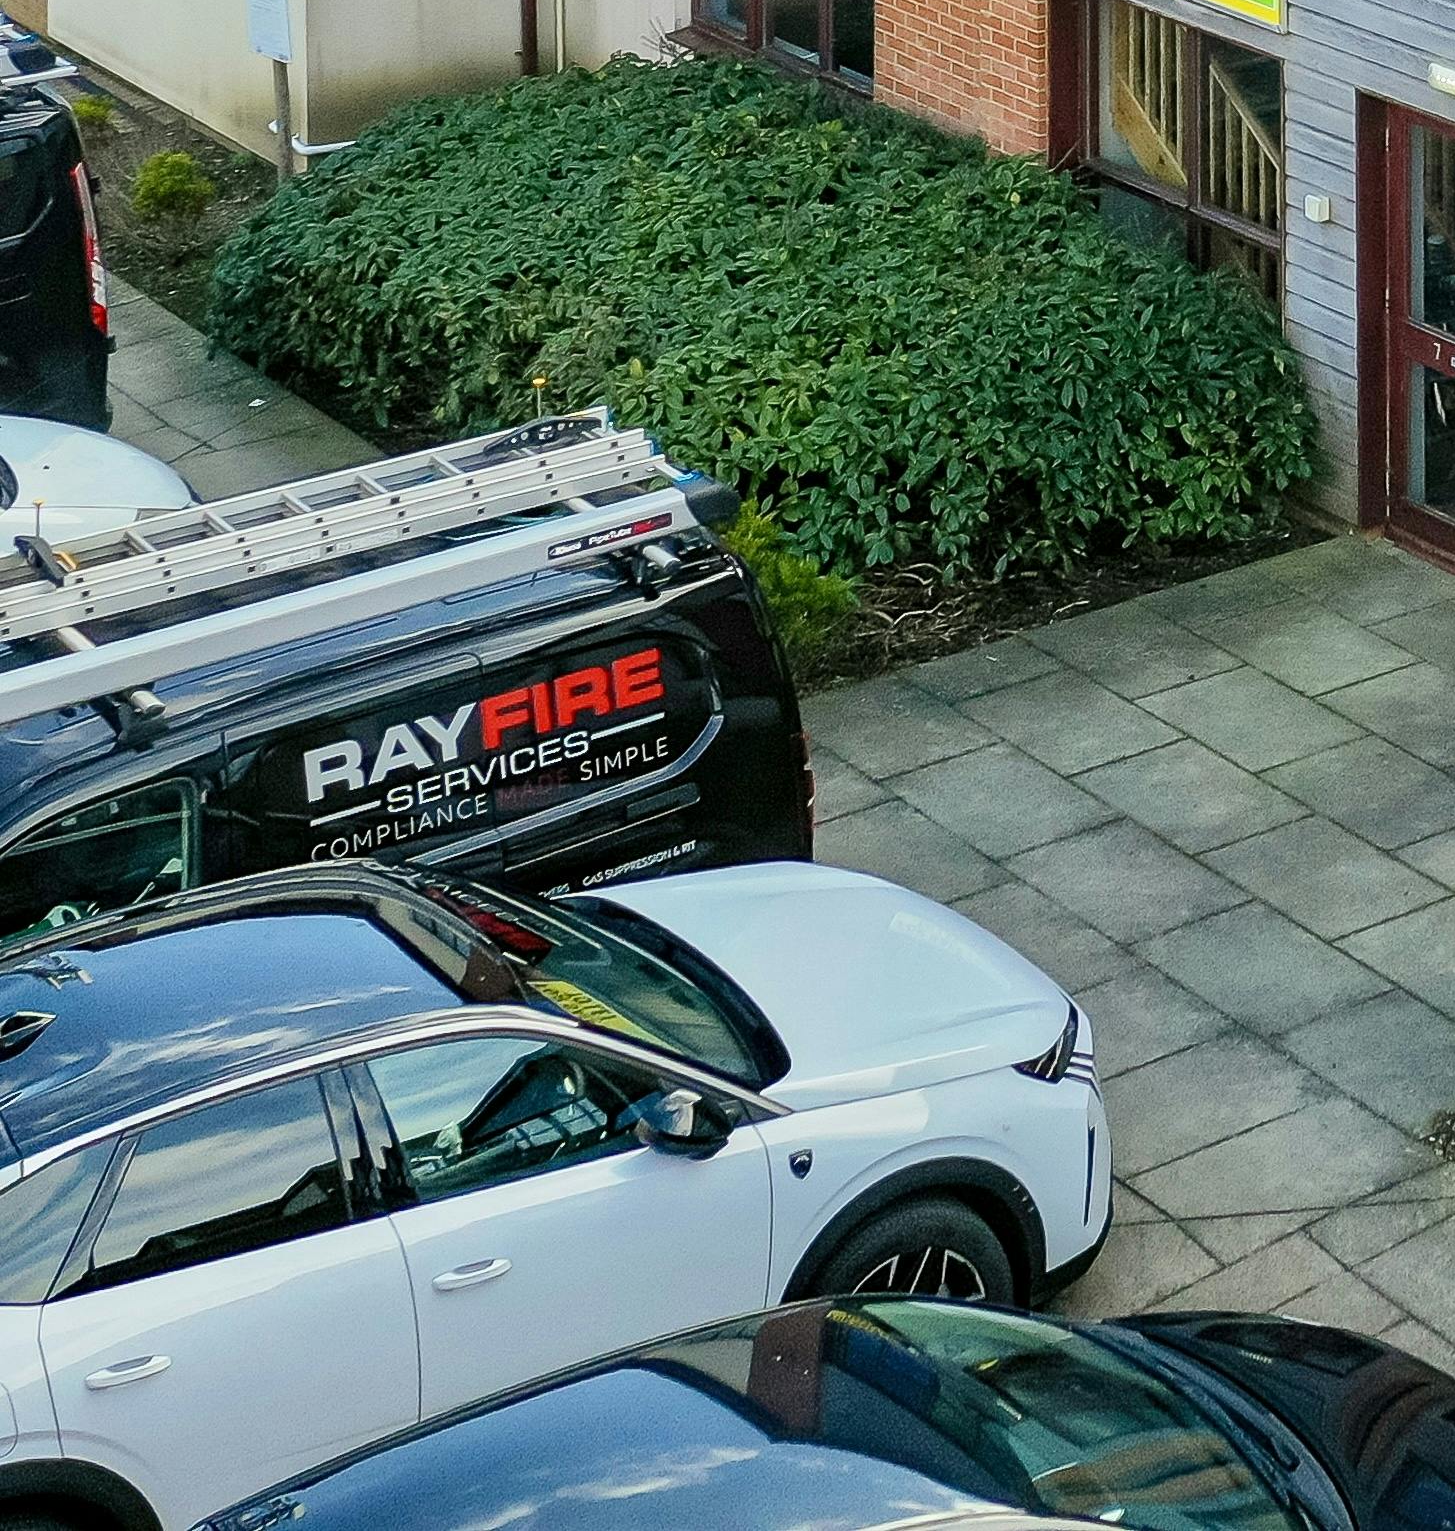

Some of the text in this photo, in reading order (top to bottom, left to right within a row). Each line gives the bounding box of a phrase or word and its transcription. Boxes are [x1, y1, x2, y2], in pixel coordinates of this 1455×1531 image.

[1433, 342, 1441, 360] 7
[303, 647, 666, 805] RAYFIRE
[385, 730, 591, 814] SERVICES
[310, 795, 489, 861] COMPLIANCE
[579, 736, 670, 782] SIMPLE
